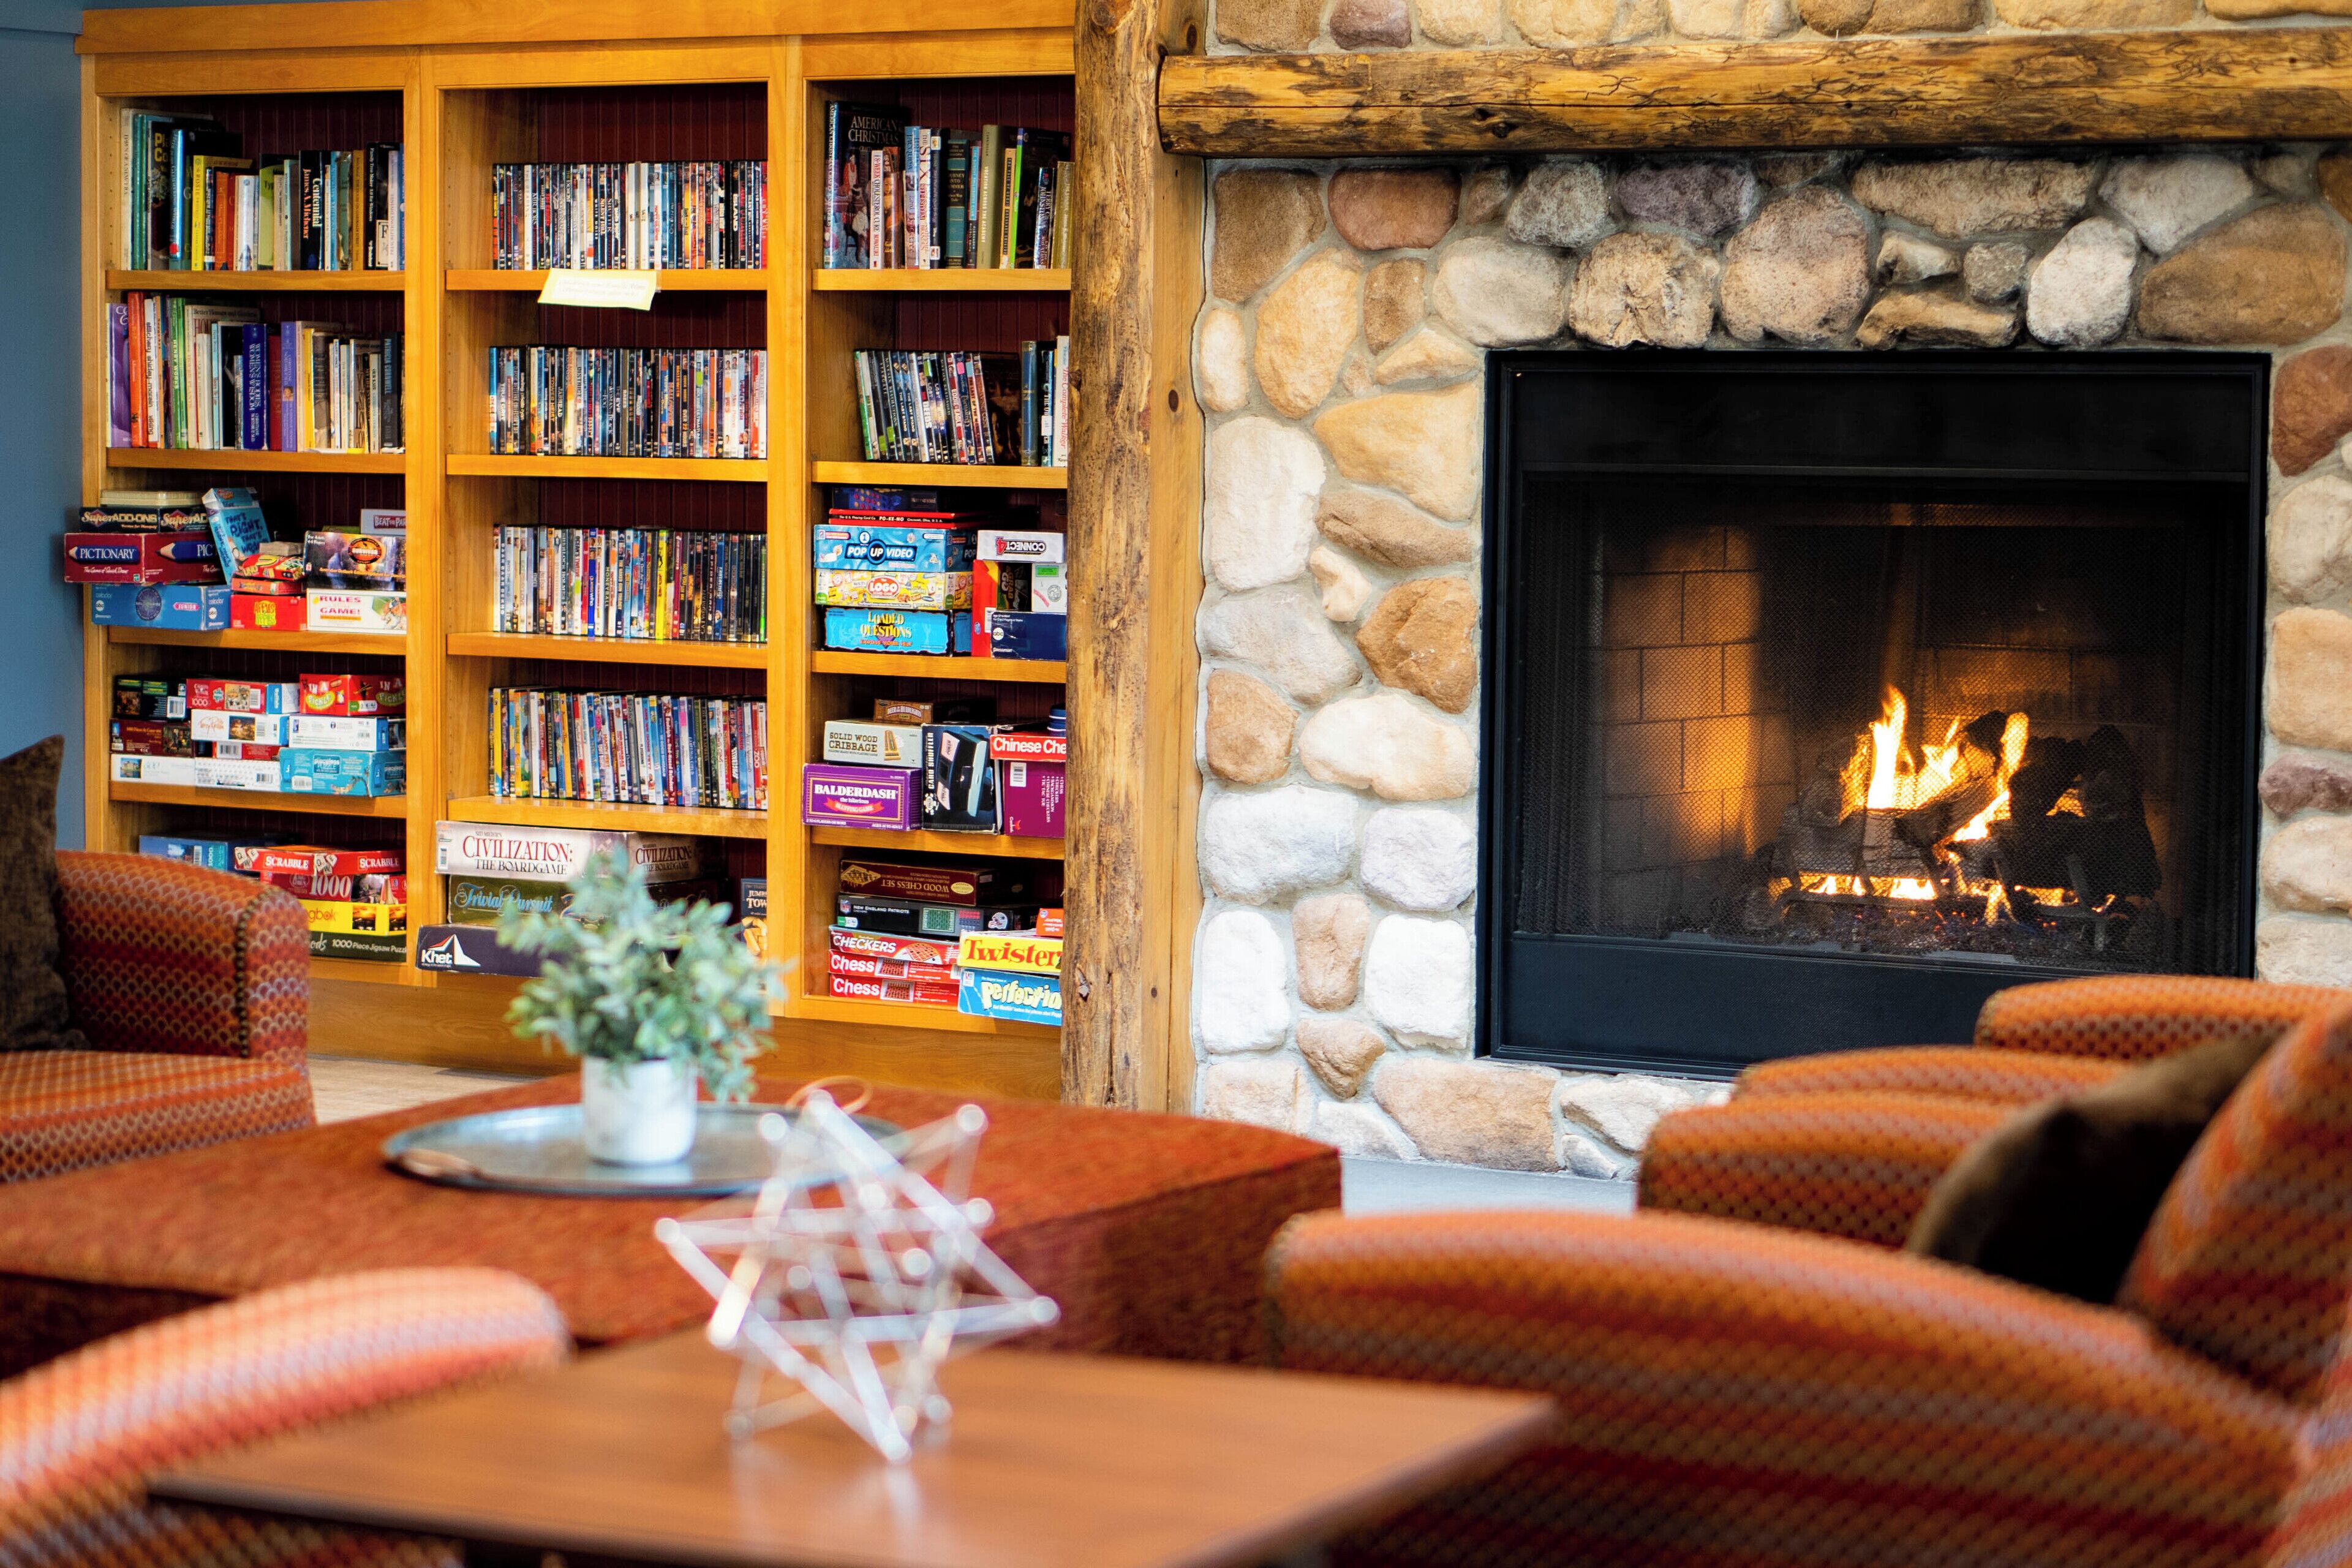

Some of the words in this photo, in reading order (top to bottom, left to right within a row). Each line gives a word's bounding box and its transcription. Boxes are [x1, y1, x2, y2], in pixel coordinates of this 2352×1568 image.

[920, 146, 929, 180] SIX
[303, 168, 311, 196] James
[312, 178, 322, 227] Centennial
[303, 203, 311, 239] Michener
[81, 511, 114, 526] Super
[113, 513, 157, 522] ADD-ONS
[375, 516, 390, 527] BEAT
[80, 548, 135, 559] PICTIONARY
[848, 547, 867, 556] POP
[870, 548, 884, 557] UP
[886, 548, 914, 559] VIDEO
[997, 537, 1007, 556] 4
[1005, 541, 1046, 552] CONNECT
[869, 583, 897, 592] LOGO
[868, 611, 905, 625] LOADED
[859, 624, 912, 638] QUESTIONS
[309, 683, 318, 694] IN
[319, 680, 329, 692] A
[380, 680, 391, 691] IN
[394, 678, 402, 687] A
[192, 698, 209, 707] 1000
[308, 693, 333, 707] PICKLE
[829, 732, 853, 741] SOLID
[855, 734, 878, 742] WOOD
[829, 741, 878, 752] CRIBBAGE
[993, 737, 1042, 754] Chinese
[1042, 739, 1067, 754] Che
[814, 784, 896, 800] BALDERDASH
[463, 835, 573, 863] CIVILIZATION:
[265, 856, 309, 869] SCRABBLE
[360, 856, 399, 869] SCRABBLE
[475, 859, 496, 870] THE
[498, 861, 567, 875] BOARDGAME
[310, 875, 352, 899] 1000
[881, 879, 895, 888] SET
[897, 880, 921, 890] CHESS
[924, 883, 949, 893] WOOD
[454, 883, 502, 908] Trivial
[332, 939, 353, 948] 1000
[369, 944, 390, 952] Jigsaw
[833, 935, 897, 954] CHECKERS
[421, 949, 453, 964] Khet
[965, 938, 1063, 968] Twister
[831, 954, 875, 973] Chess
[833, 978, 880, 996] Chess
